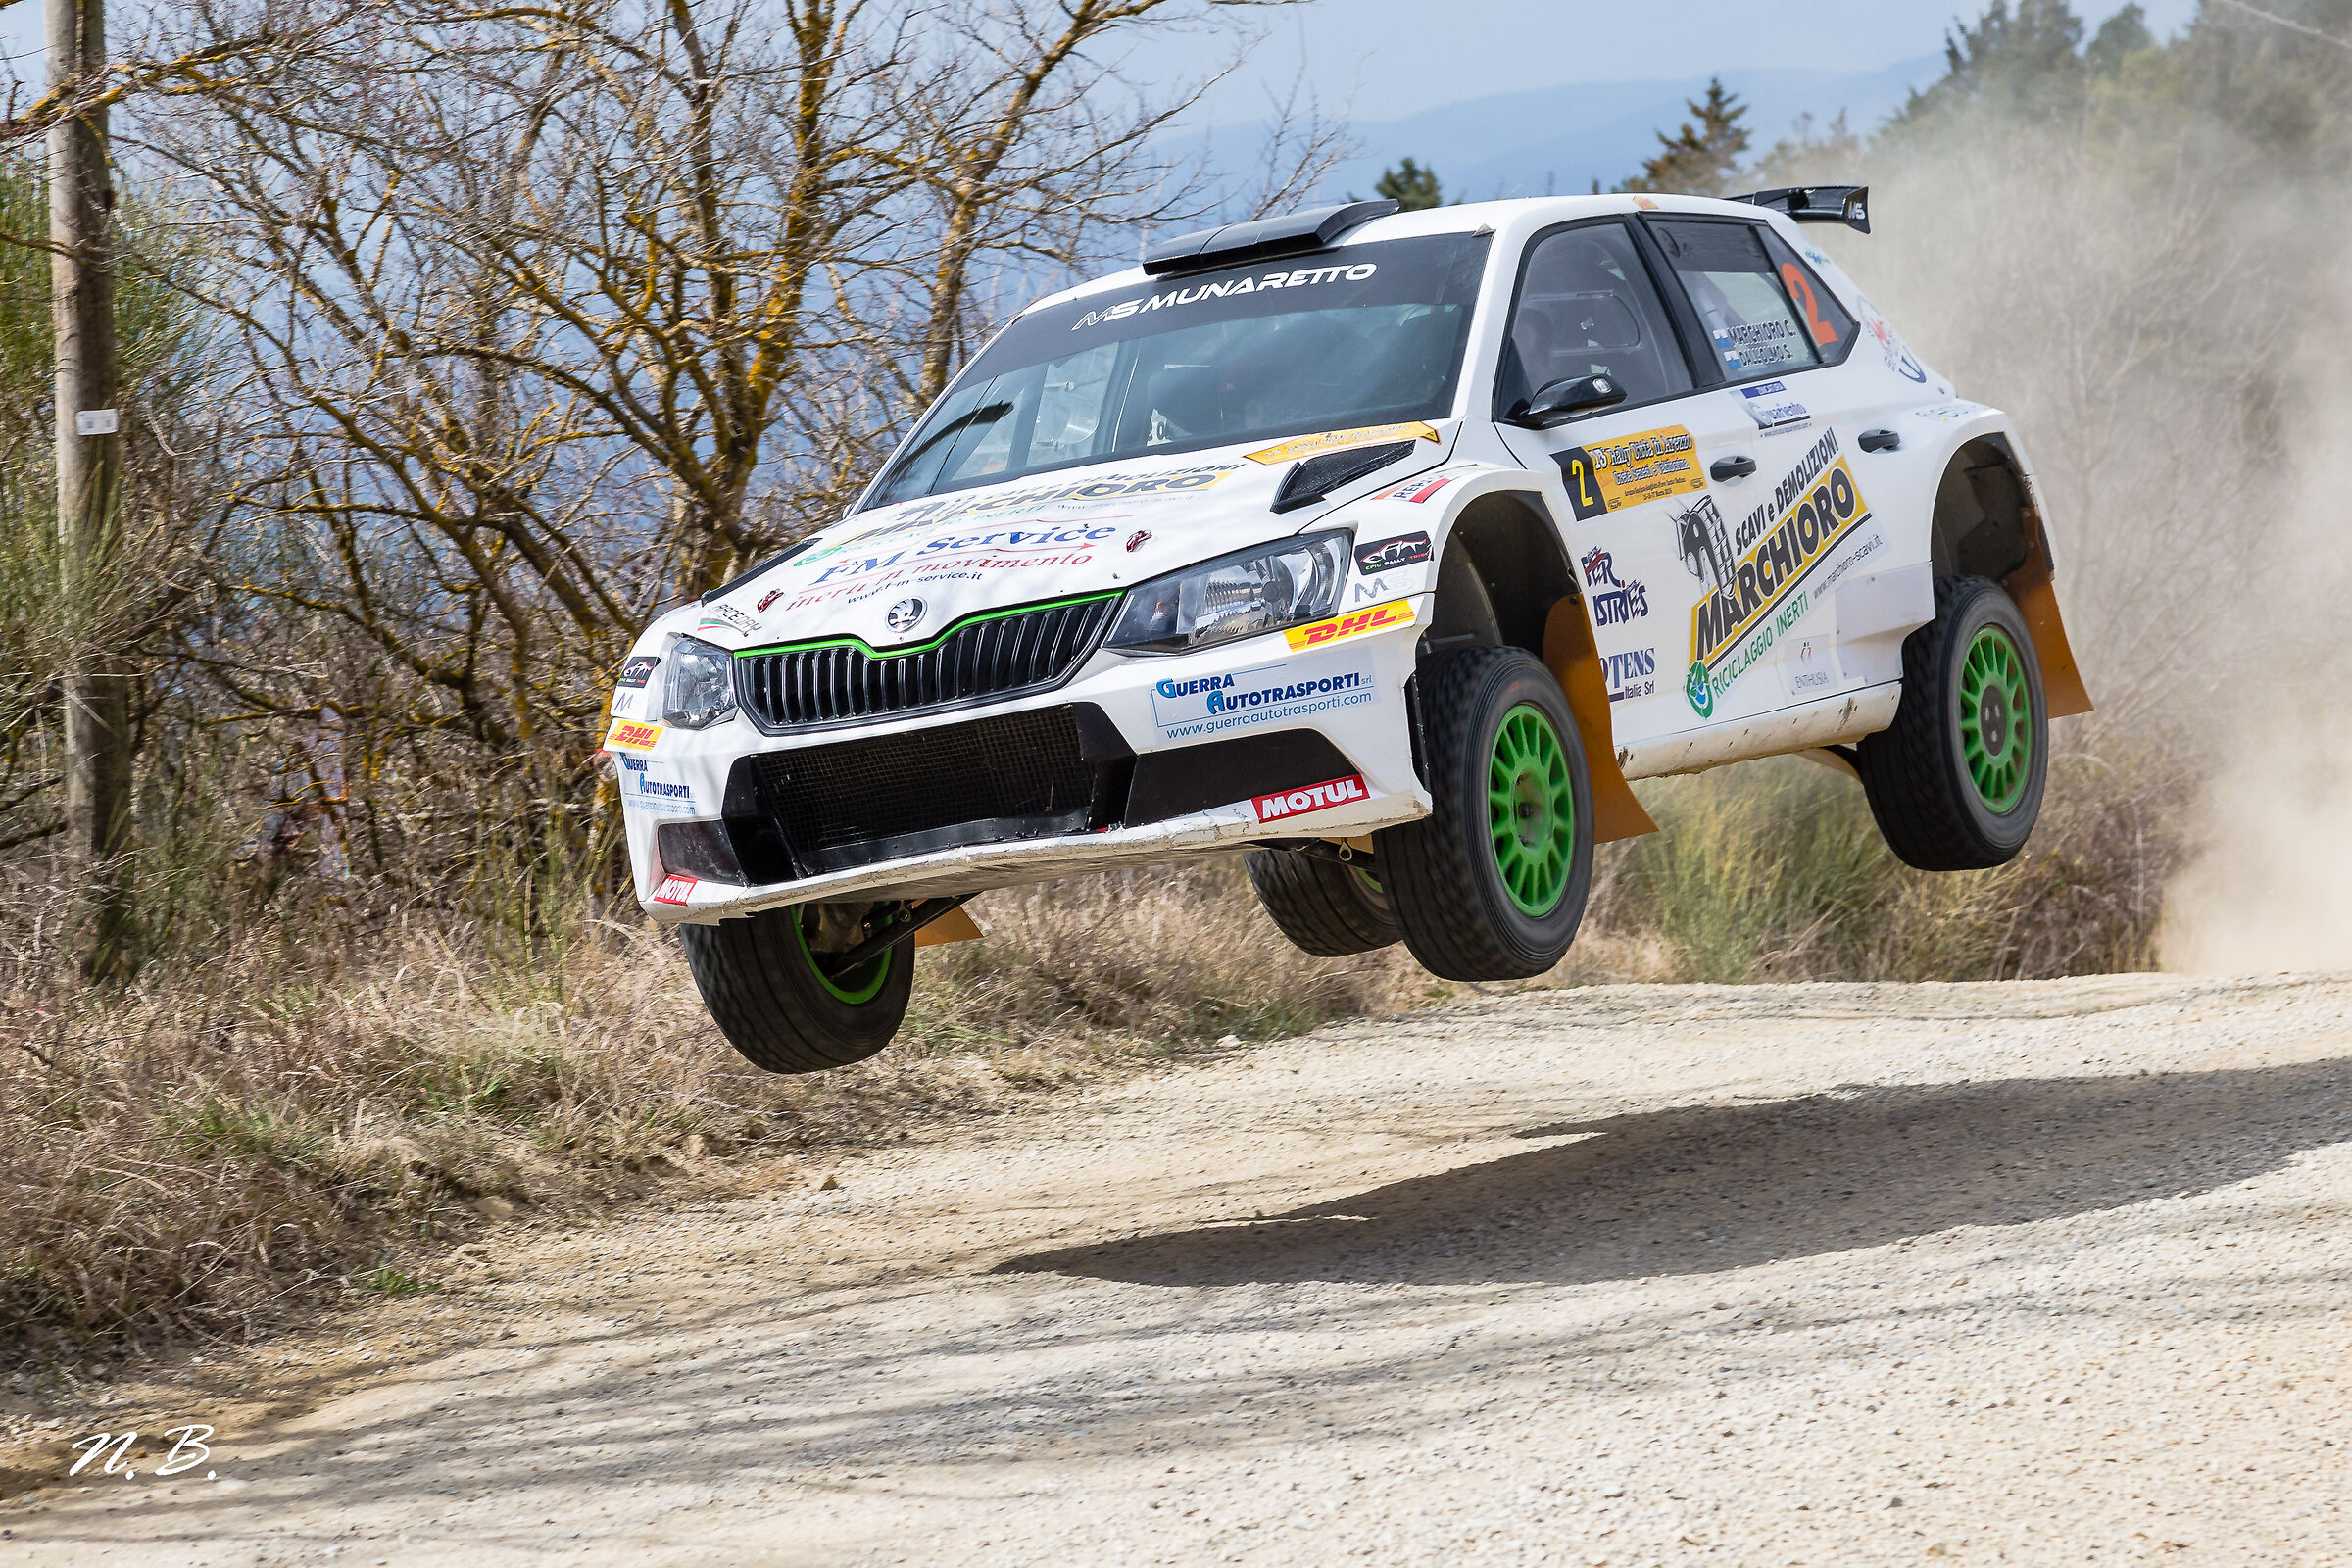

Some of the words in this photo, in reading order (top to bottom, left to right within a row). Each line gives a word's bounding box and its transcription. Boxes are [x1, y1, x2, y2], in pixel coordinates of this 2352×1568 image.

[1138, 263, 1378, 315] MUNARETTO
[1782, 262, 1838, 344] 2
[1571, 459, 1594, 507] 2
[1735, 504, 1766, 556] SCAVI
[1767, 503, 1775, 522] e
[1774, 427, 1839, 515] DEMOLIZIONI
[911, 553, 1093, 575] movimento
[1384, 557, 1405, 565] RALLY
[1697, 467, 1855, 660] MARCHIORO
[1303, 608, 1398, 645] DHL
[1711, 626, 1774, 698] RICICLAGGIO
[1775, 590, 1809, 637] INERTI
[1156, 673, 1235, 699] GUERRA
[1207, 672, 1360, 715] AUTOTRASPORTI
[1361, 675, 1372, 686] srl
[1625, 683, 1642, 700] Italia
[1644, 680, 1655, 696] Srl
[615, 725, 656, 747] DHL
[1166, 691, 1372, 740] www.guerraautotrasporti.com
[1262, 779, 1364, 820] MOTUL
[656, 878, 695, 902] MOTUL
